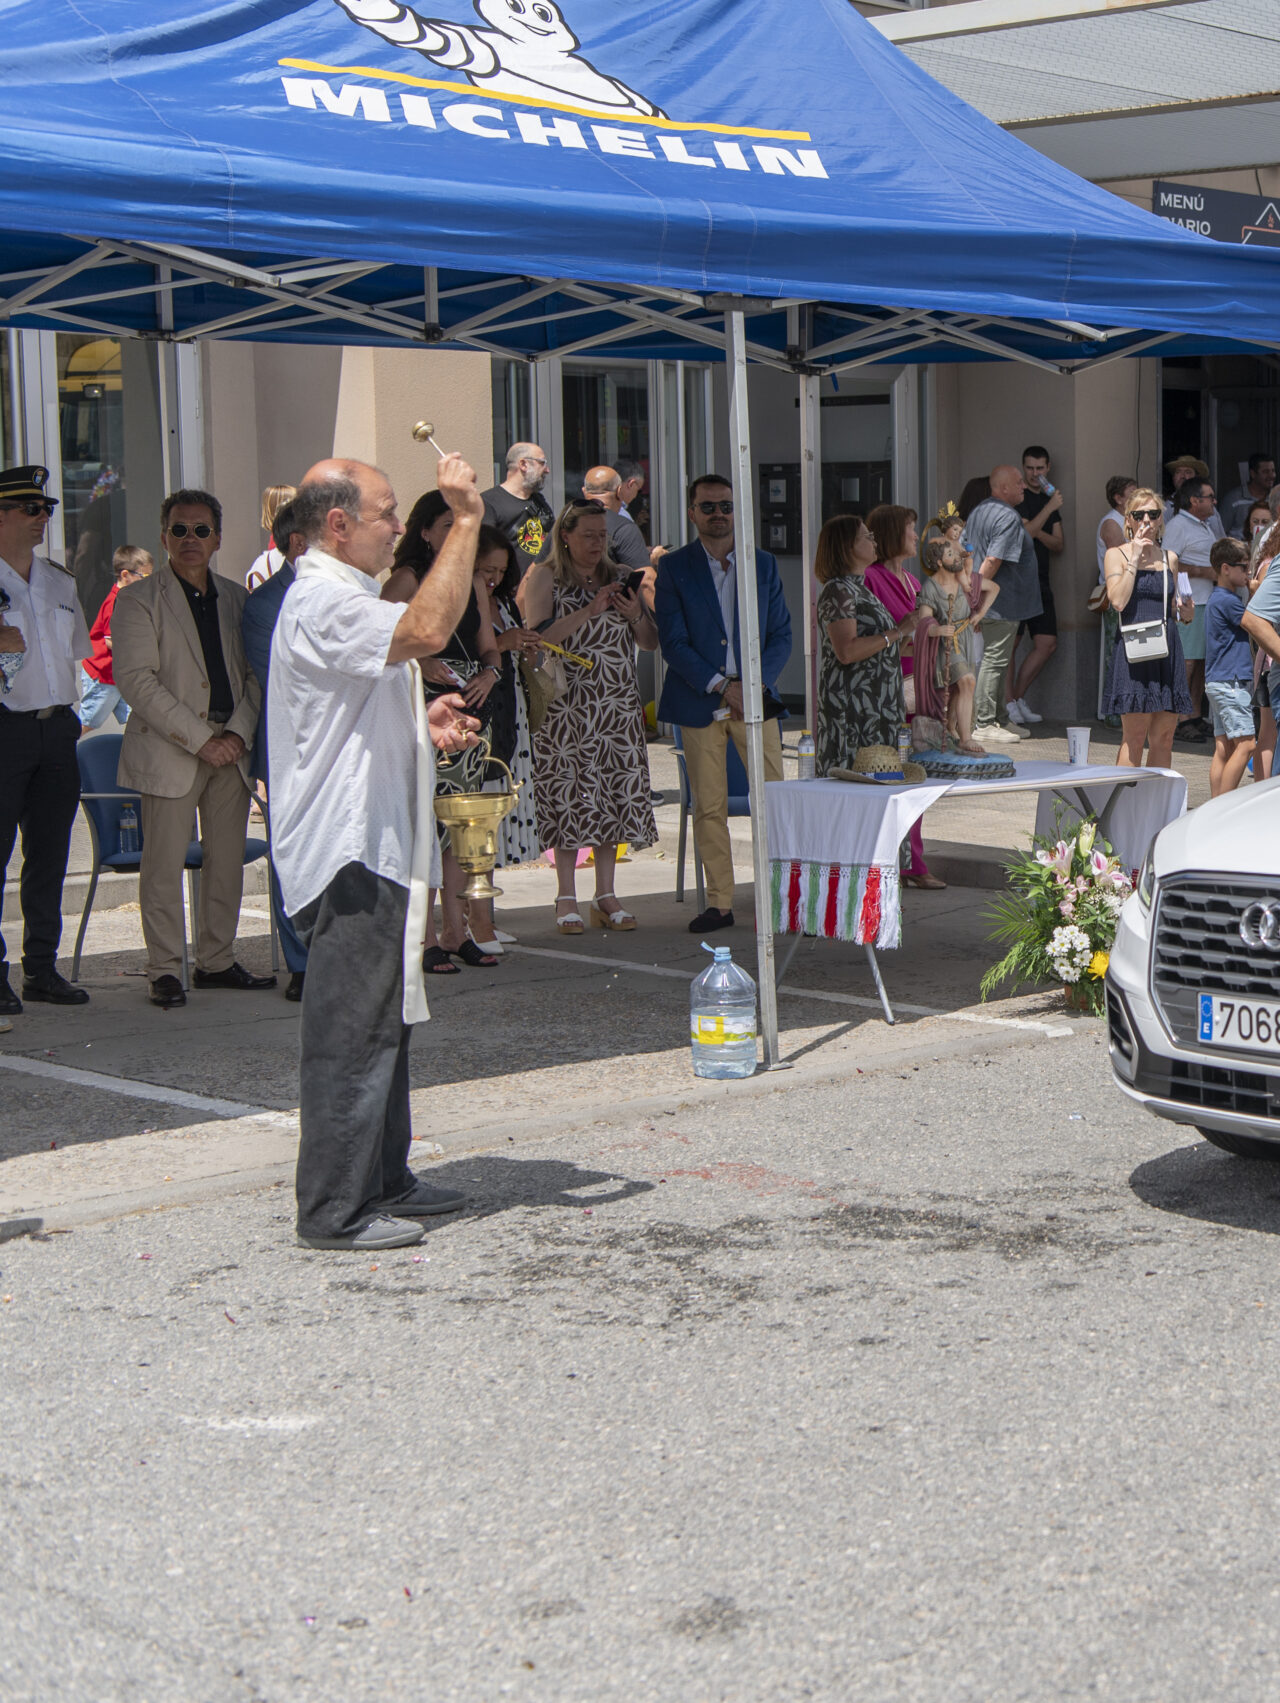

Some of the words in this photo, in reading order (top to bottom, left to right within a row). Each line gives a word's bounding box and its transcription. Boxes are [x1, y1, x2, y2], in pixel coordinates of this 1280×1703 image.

[281, 76, 830, 180] MICHELIN
[1160, 192, 1204, 212] MENÚ
[1161, 216, 1211, 236] ARIO
[1203, 1021, 1210, 1034] E
